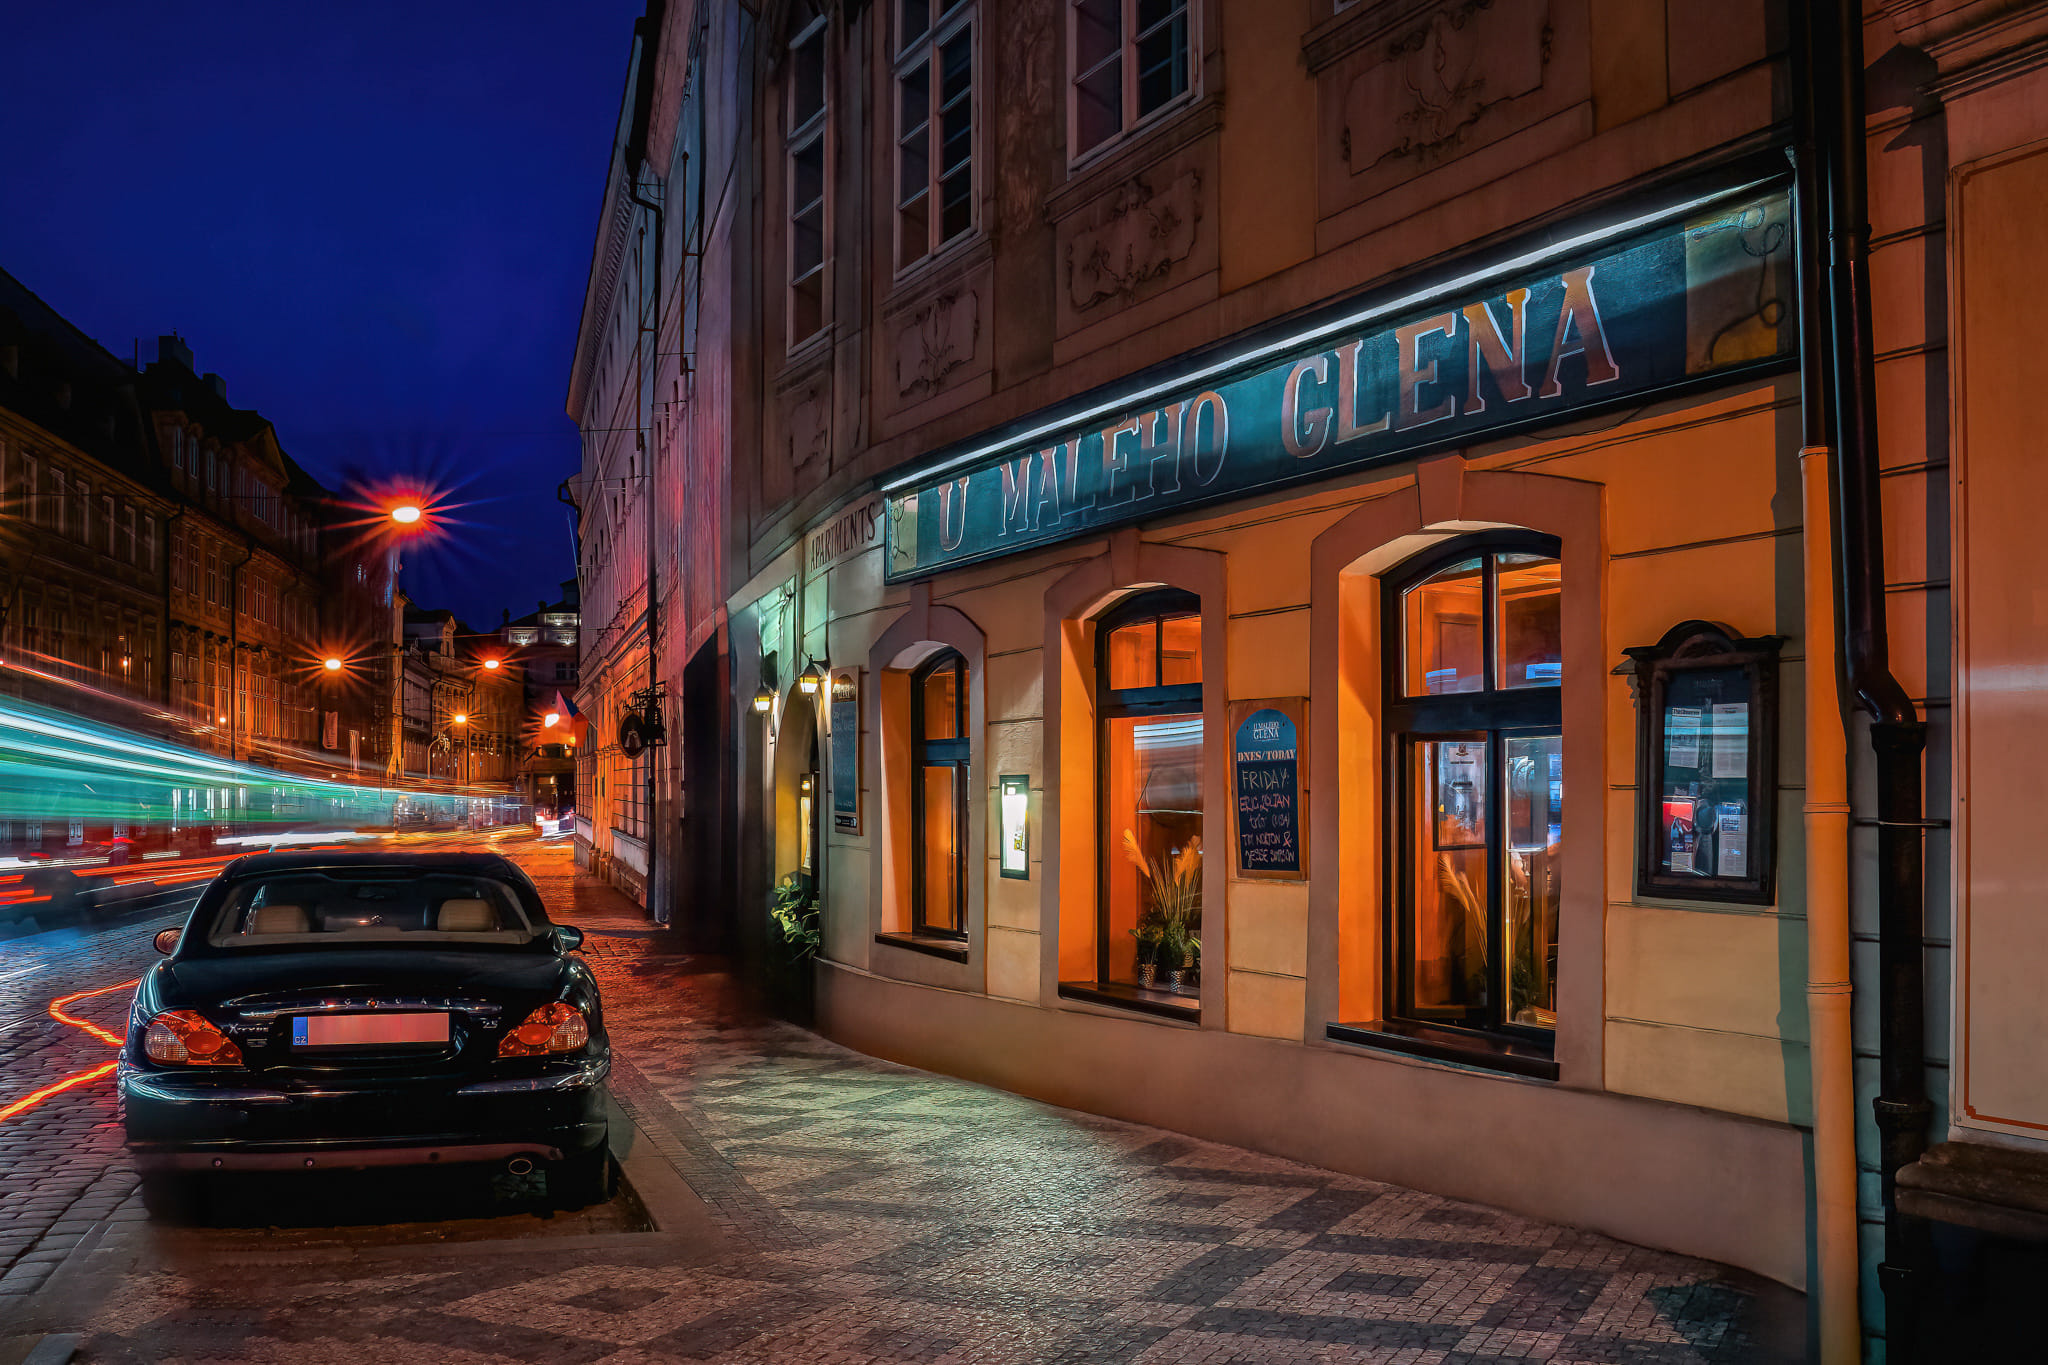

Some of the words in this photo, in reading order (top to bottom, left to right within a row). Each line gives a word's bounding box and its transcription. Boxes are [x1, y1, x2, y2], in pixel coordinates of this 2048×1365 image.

[938, 475, 970, 552] U
[998, 390, 1229, 537] MALÉHO
[1281, 265, 1620, 459] GLENA
[811, 502, 876, 573] APARTMENTS
